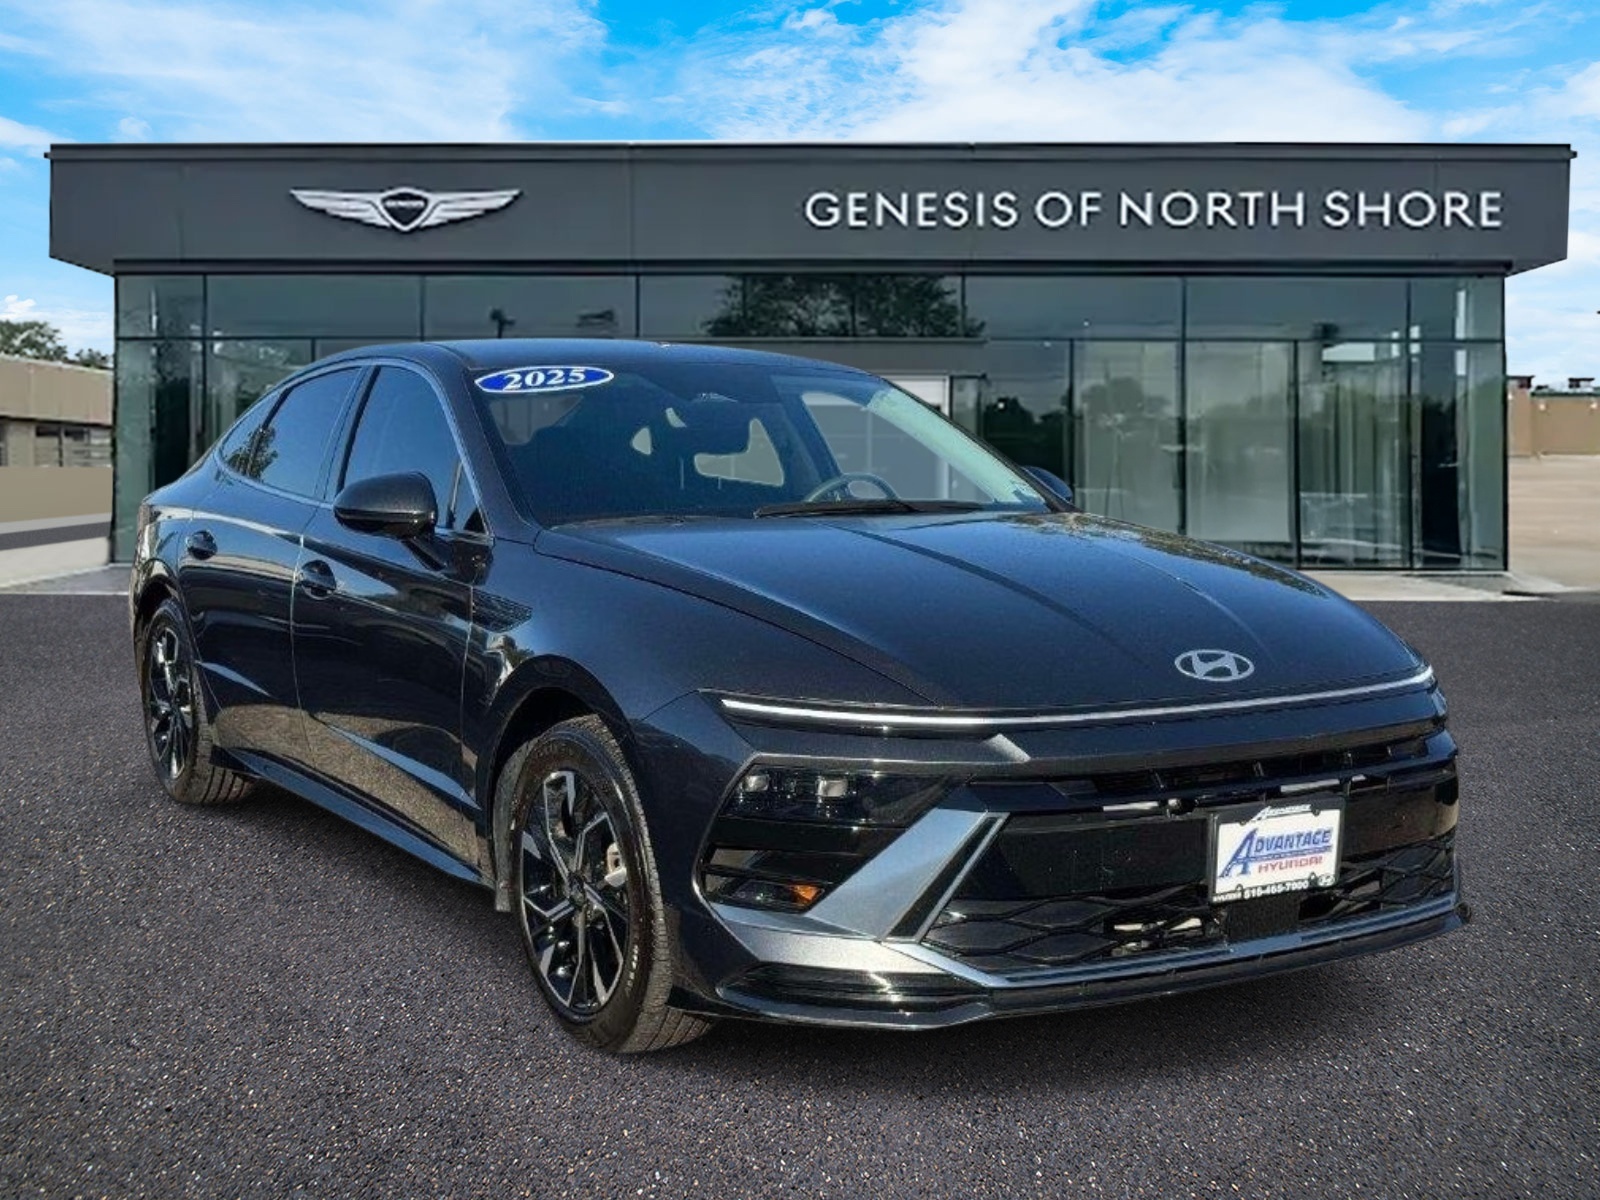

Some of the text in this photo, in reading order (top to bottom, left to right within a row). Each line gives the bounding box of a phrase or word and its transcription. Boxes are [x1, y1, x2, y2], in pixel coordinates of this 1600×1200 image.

[805, 190, 1502, 227] GENESIS OF NORTH SHORE
[502, 368, 586, 391] 2025
[1219, 828, 1332, 877] ADVANTAGE
[1258, 856, 1323, 873] HYUNDAI
